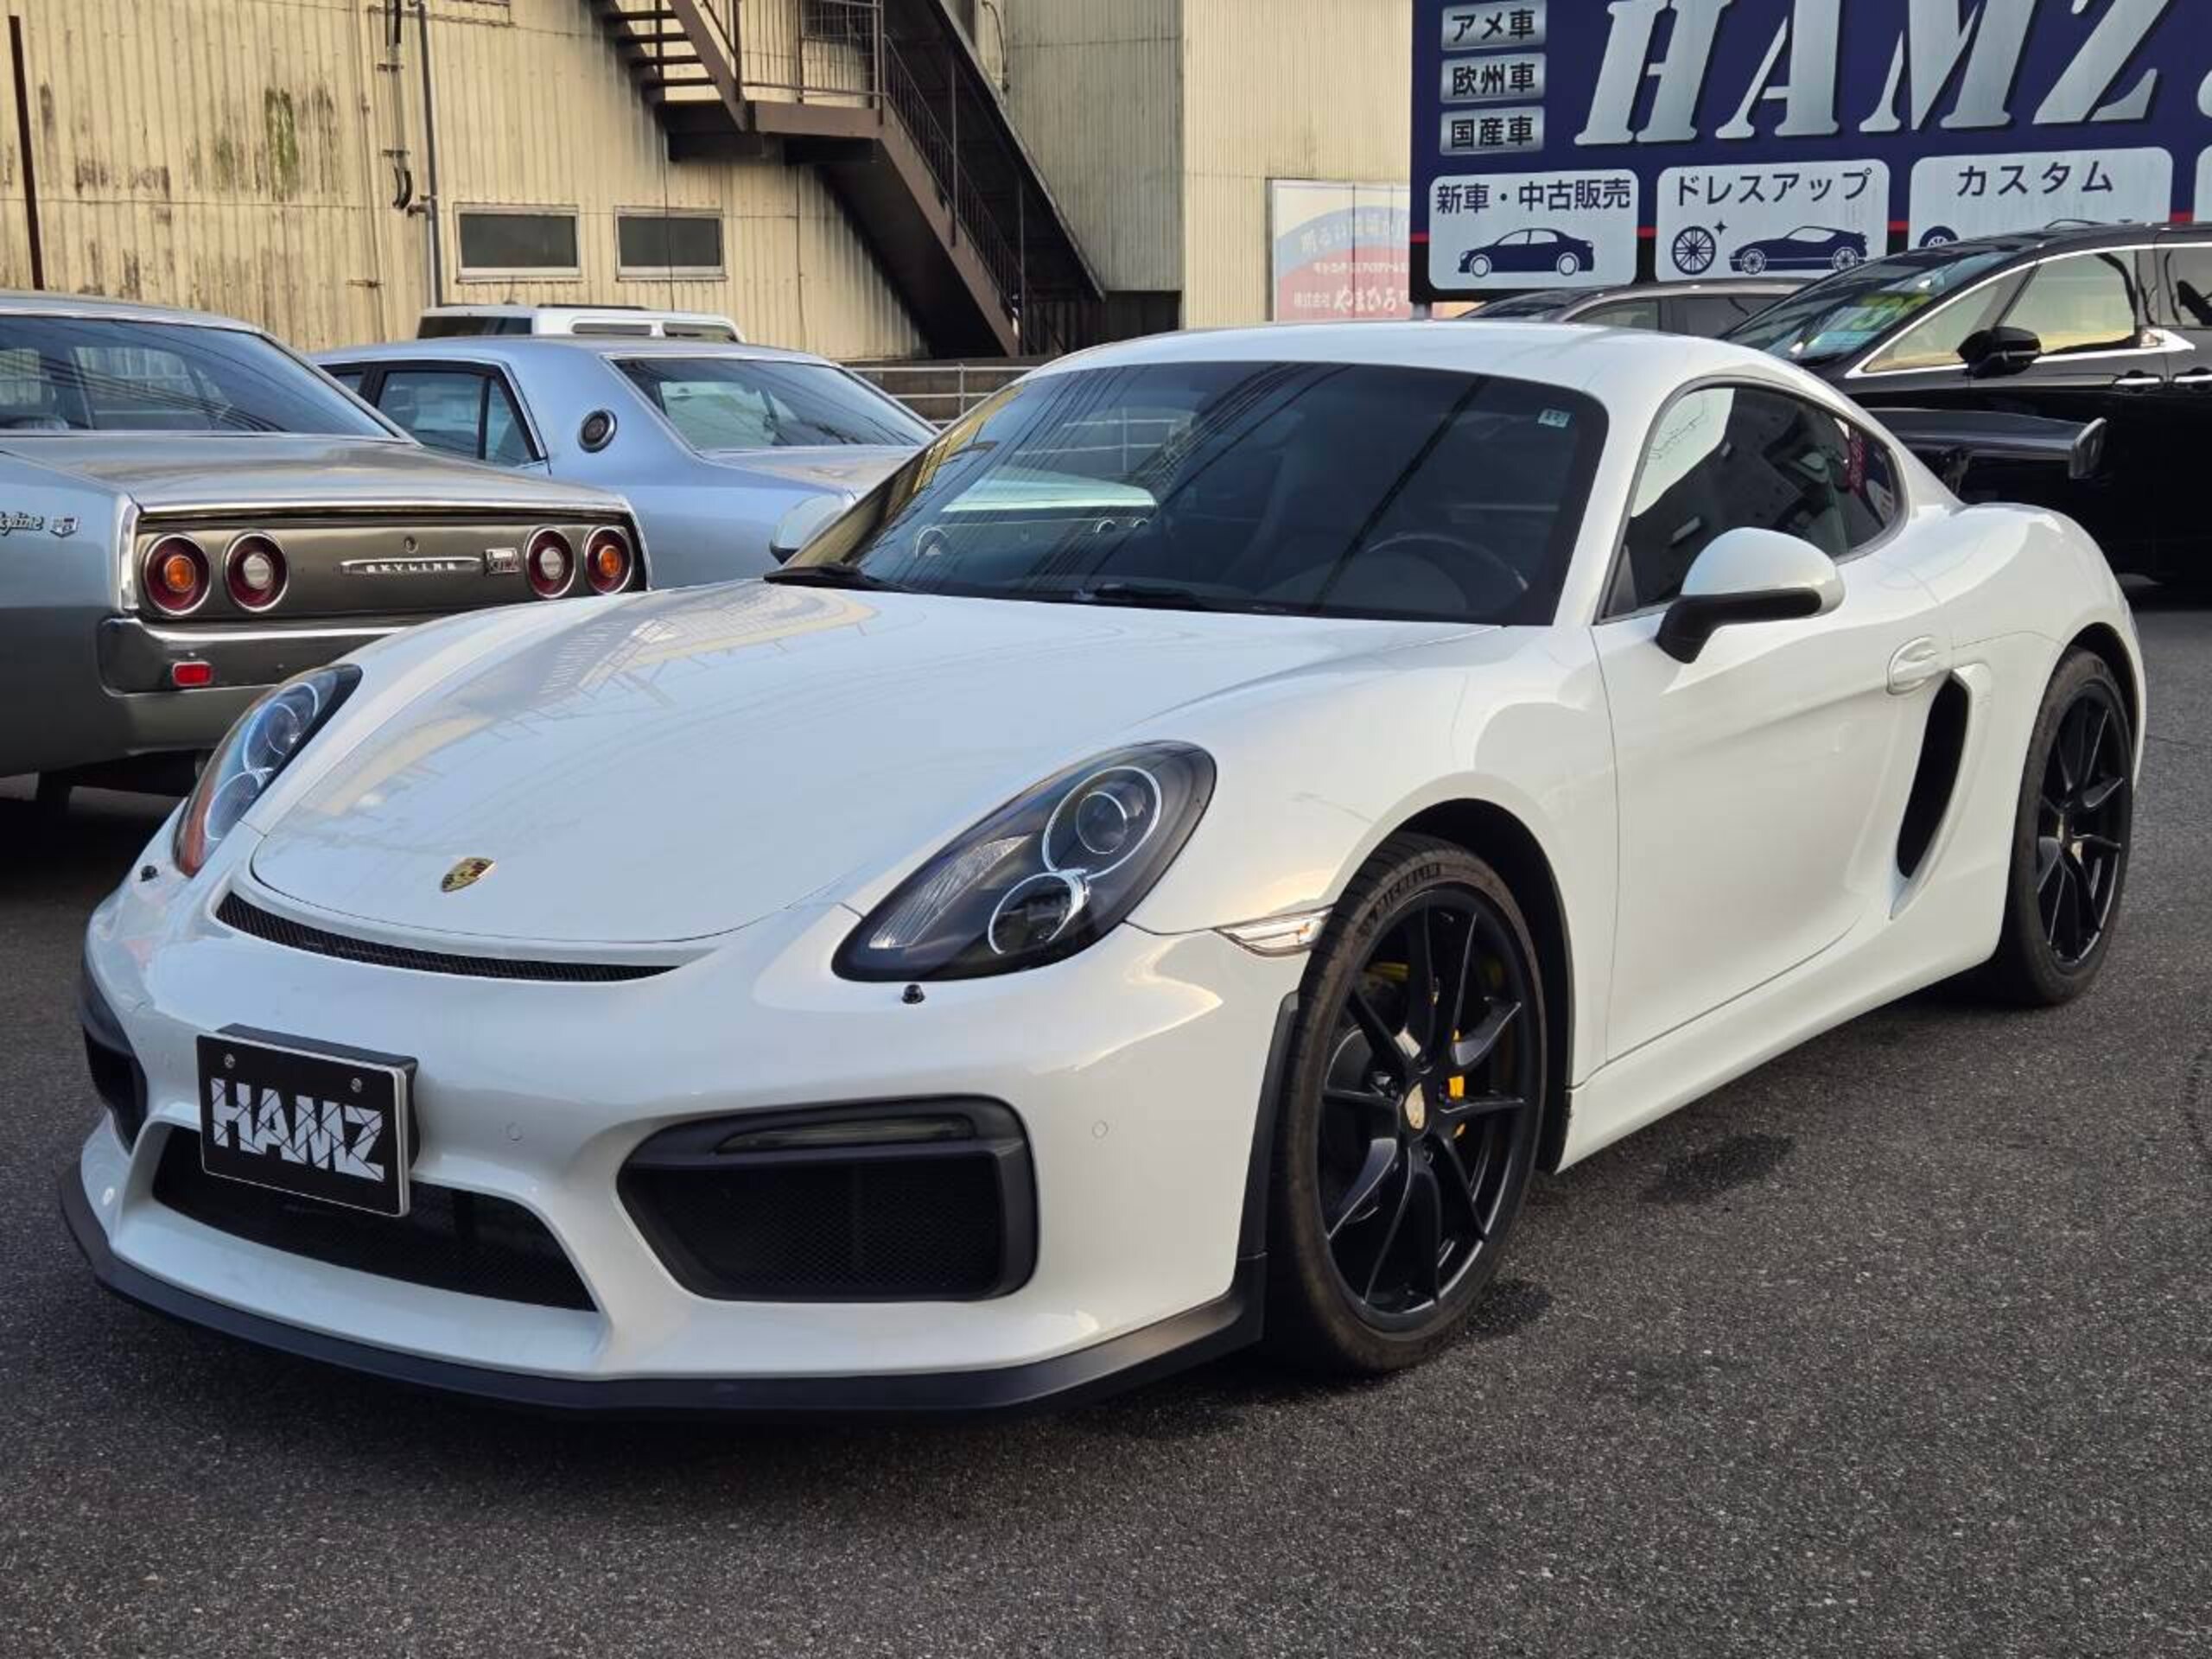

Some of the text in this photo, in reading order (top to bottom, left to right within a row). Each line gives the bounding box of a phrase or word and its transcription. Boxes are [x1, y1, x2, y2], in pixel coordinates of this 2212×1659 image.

[1452, 8, 1535, 42] アメ車
[1452, 61, 1535, 97] 欧州車
[1574, 0, 2166, 145] HAMZ
[1450, 114, 1534, 149] 国産車
[1437, 177, 1631, 214] 新車・中古販売
[1679, 167, 1872, 207] ドレスアップ
[1957, 161, 2113, 197] カスタム
[365, 563, 457, 574] SKYLINE
[210, 1077, 385, 1182] HAMZ
